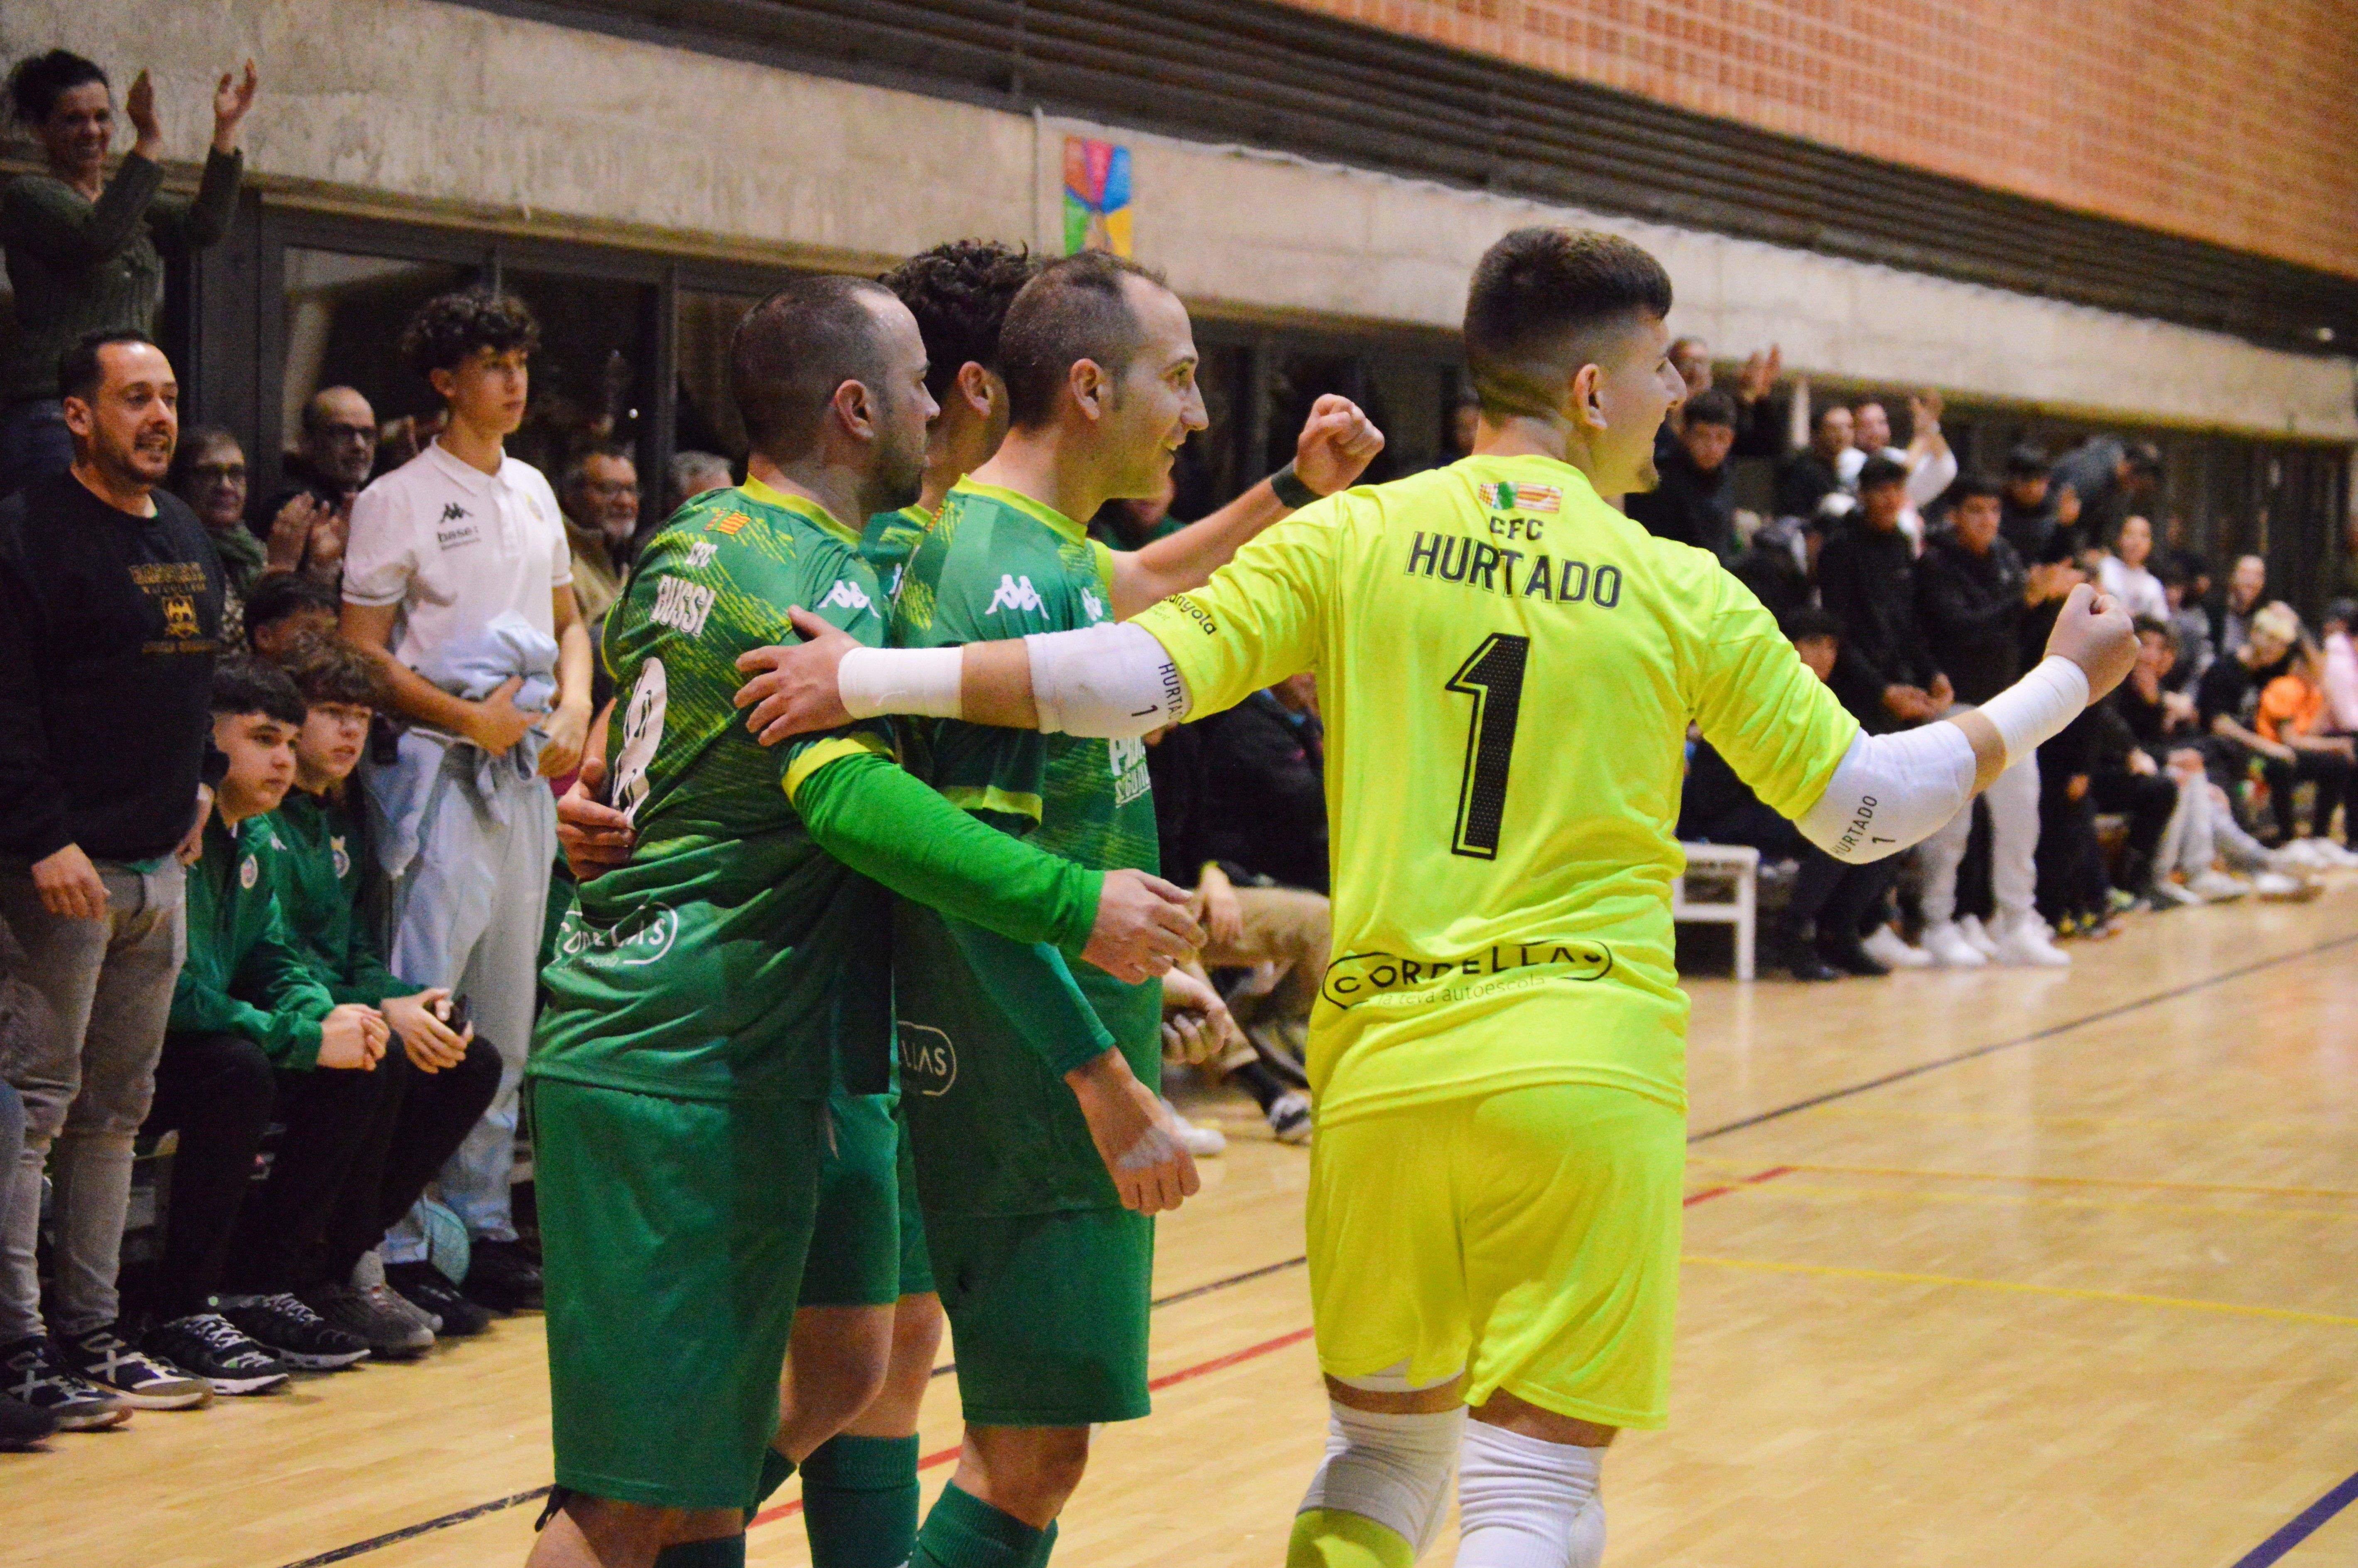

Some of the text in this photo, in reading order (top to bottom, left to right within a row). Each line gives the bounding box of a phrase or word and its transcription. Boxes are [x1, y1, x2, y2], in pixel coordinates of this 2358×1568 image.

[1489, 515, 1544, 540] CFC
[686, 541, 718, 567] CFC
[1404, 531, 1623, 610] HURTADO
[649, 574, 716, 637] BUSSI
[1163, 593, 1217, 635] anyola
[1131, 704, 1158, 717] 1
[1445, 632, 1529, 860] 1
[1830, 796, 1877, 856] HURTADO
[1443, 974, 1545, 1002] autoescola
[899, 1040, 947, 1076] LLAS
